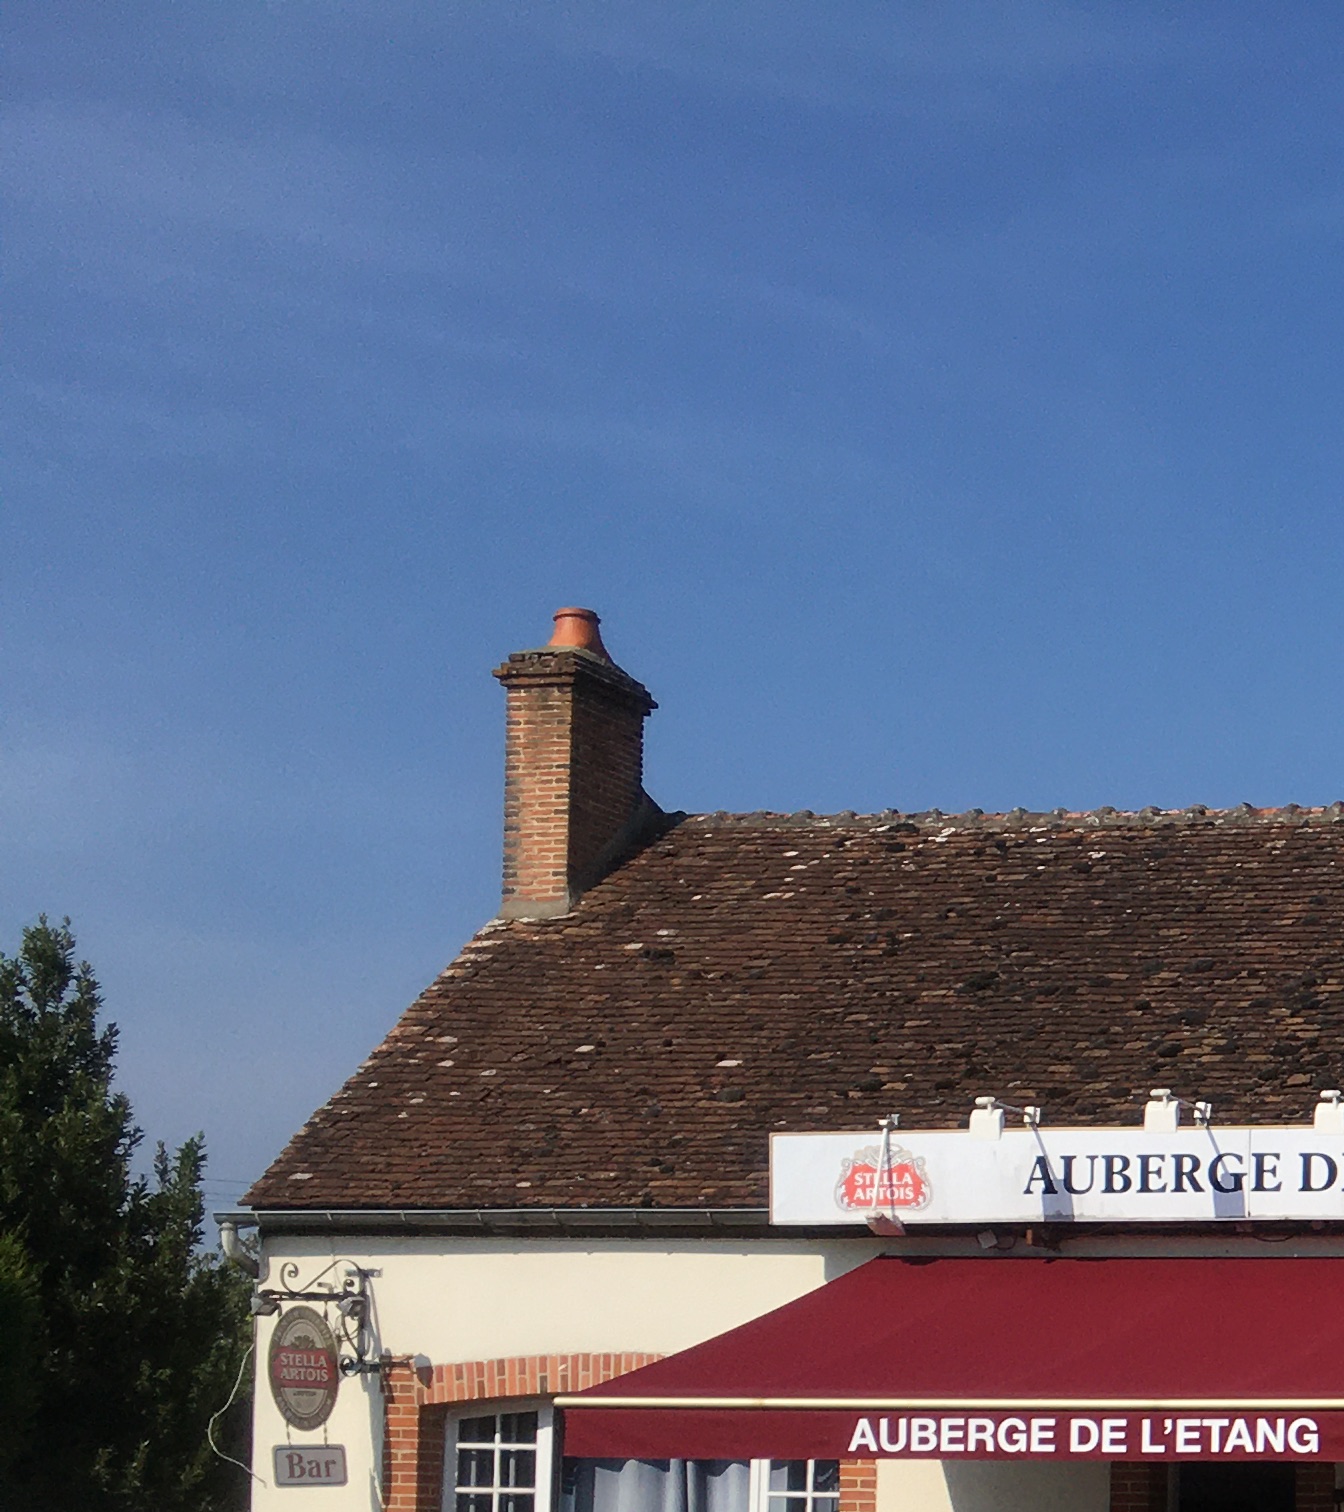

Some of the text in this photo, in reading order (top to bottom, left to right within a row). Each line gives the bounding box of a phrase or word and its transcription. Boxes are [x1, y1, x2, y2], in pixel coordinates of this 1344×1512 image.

[853, 1171, 914, 1186] STELLA
[1023, 1151, 1283, 1195] AUBERGE
[853, 1187, 915, 1201] ARTOIS
[280, 1352, 328, 1368] STELLA
[280, 1367, 329, 1382] ARTOIS
[847, 1417, 1319, 1454] AUBERGE DE L'ETANG
[286, 1451, 337, 1479] Bar
